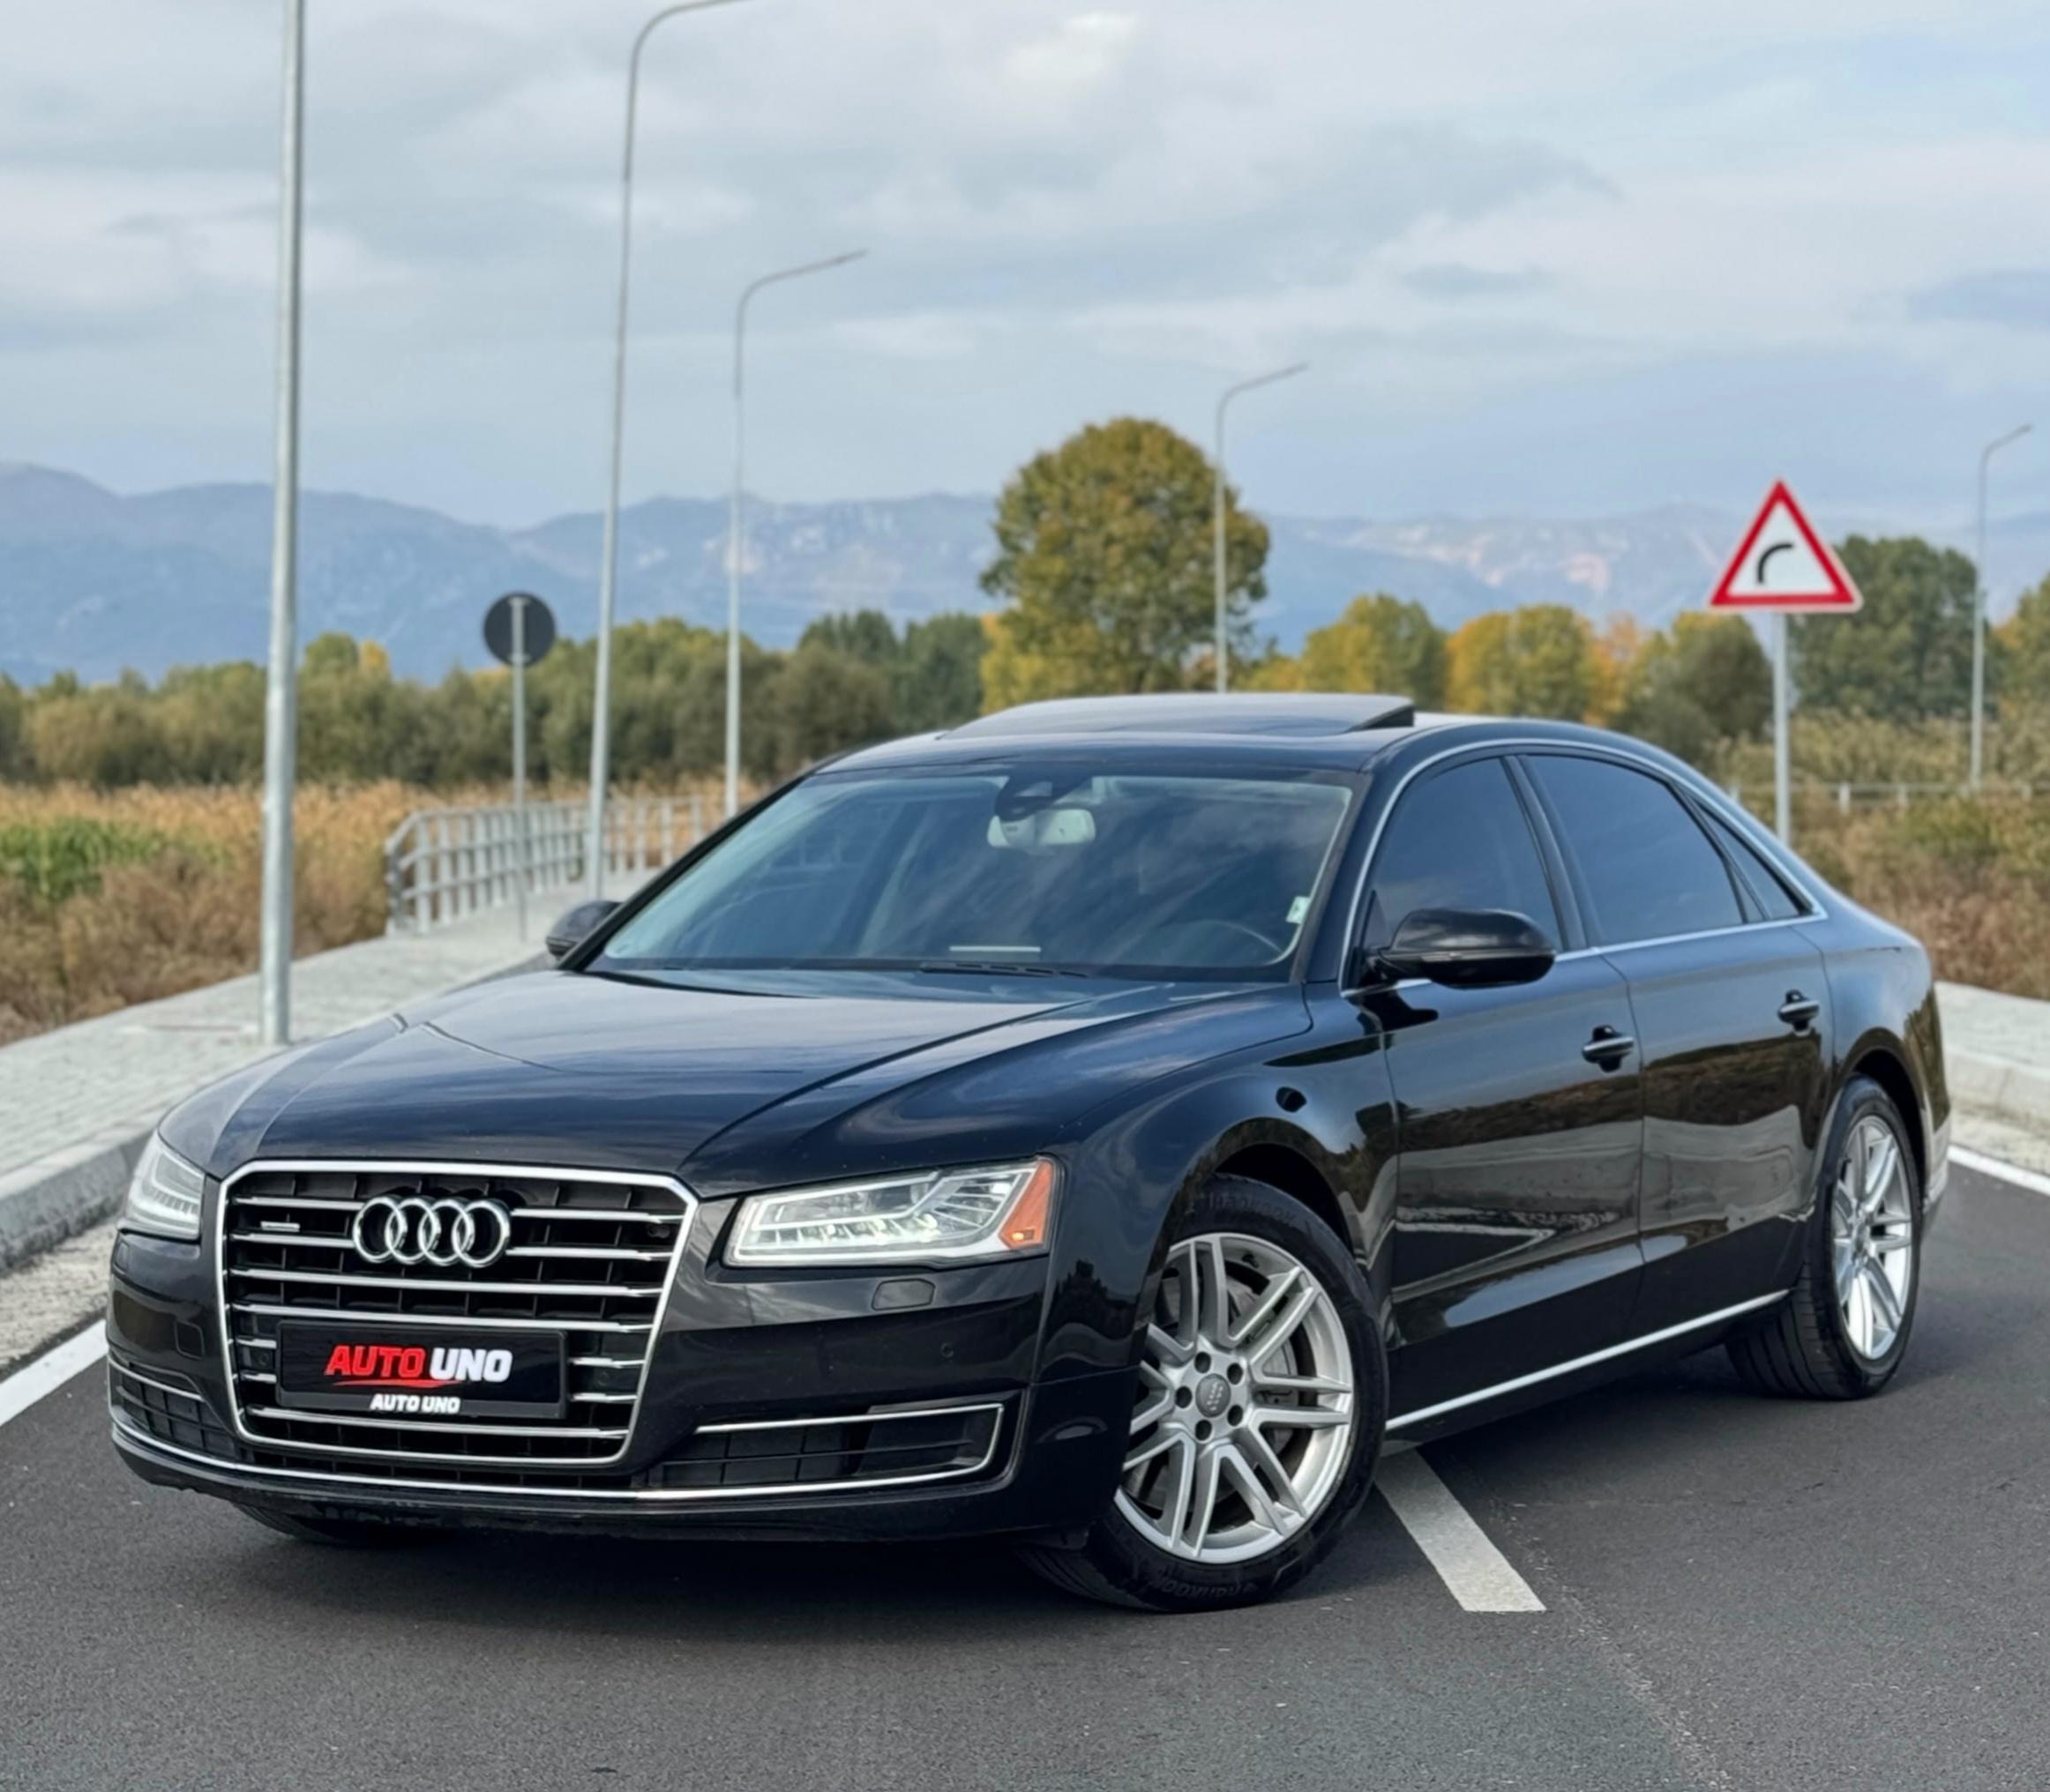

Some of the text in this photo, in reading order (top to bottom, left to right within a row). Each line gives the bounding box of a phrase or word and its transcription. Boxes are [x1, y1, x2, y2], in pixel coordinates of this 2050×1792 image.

[324, 1345, 512, 1383] AUTO UNO
[370, 1393, 461, 1415] AUTO UNO
